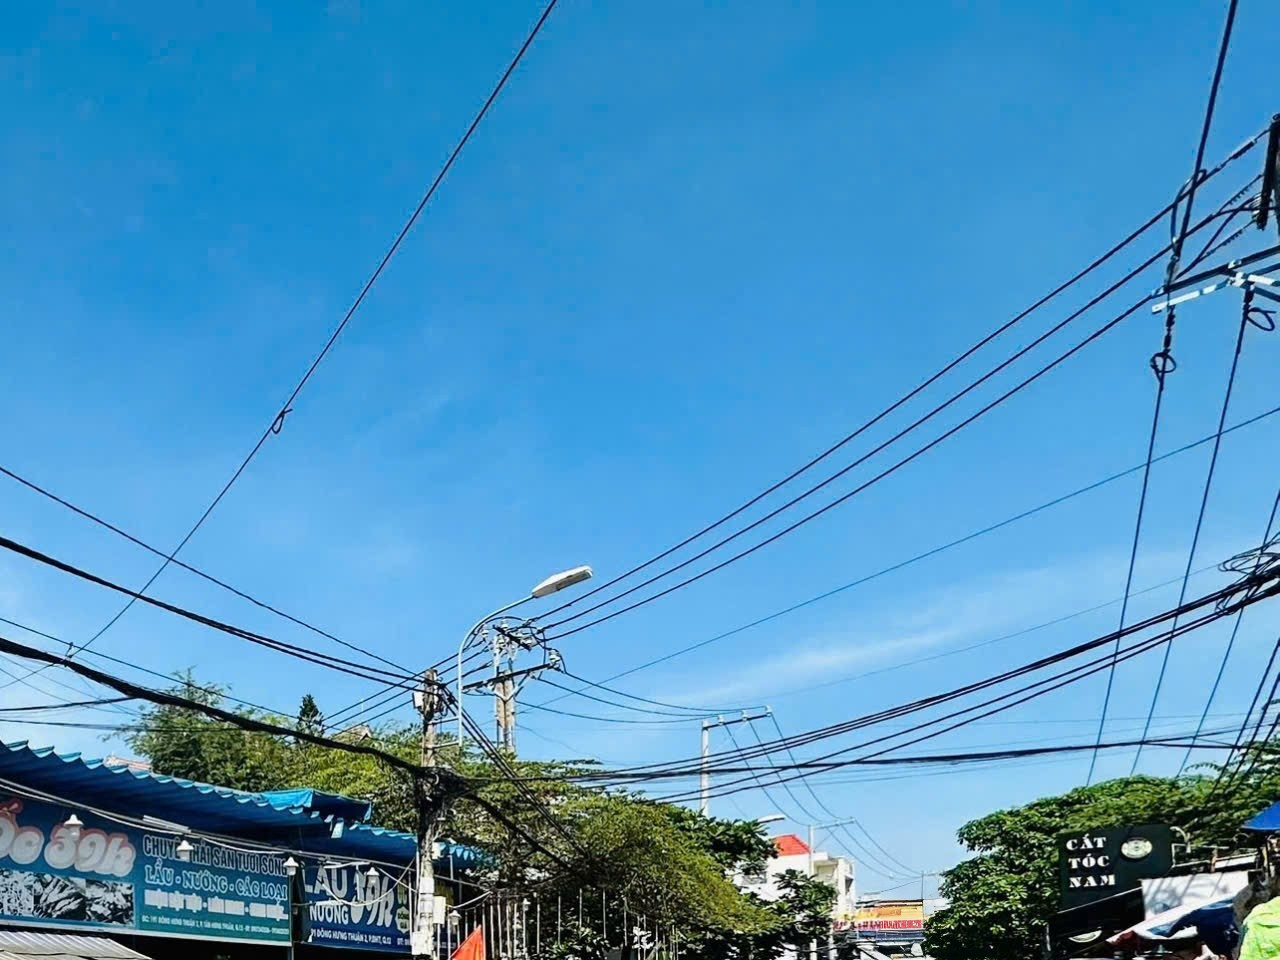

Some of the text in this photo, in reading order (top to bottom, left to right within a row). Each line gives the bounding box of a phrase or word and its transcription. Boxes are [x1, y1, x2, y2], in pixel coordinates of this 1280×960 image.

[143, 834, 190, 863] CHUYÊ
[1066, 833, 1107, 850] CẮT
[1068, 853, 1110, 869] TÓC
[1069, 874, 1116, 888] NAM
